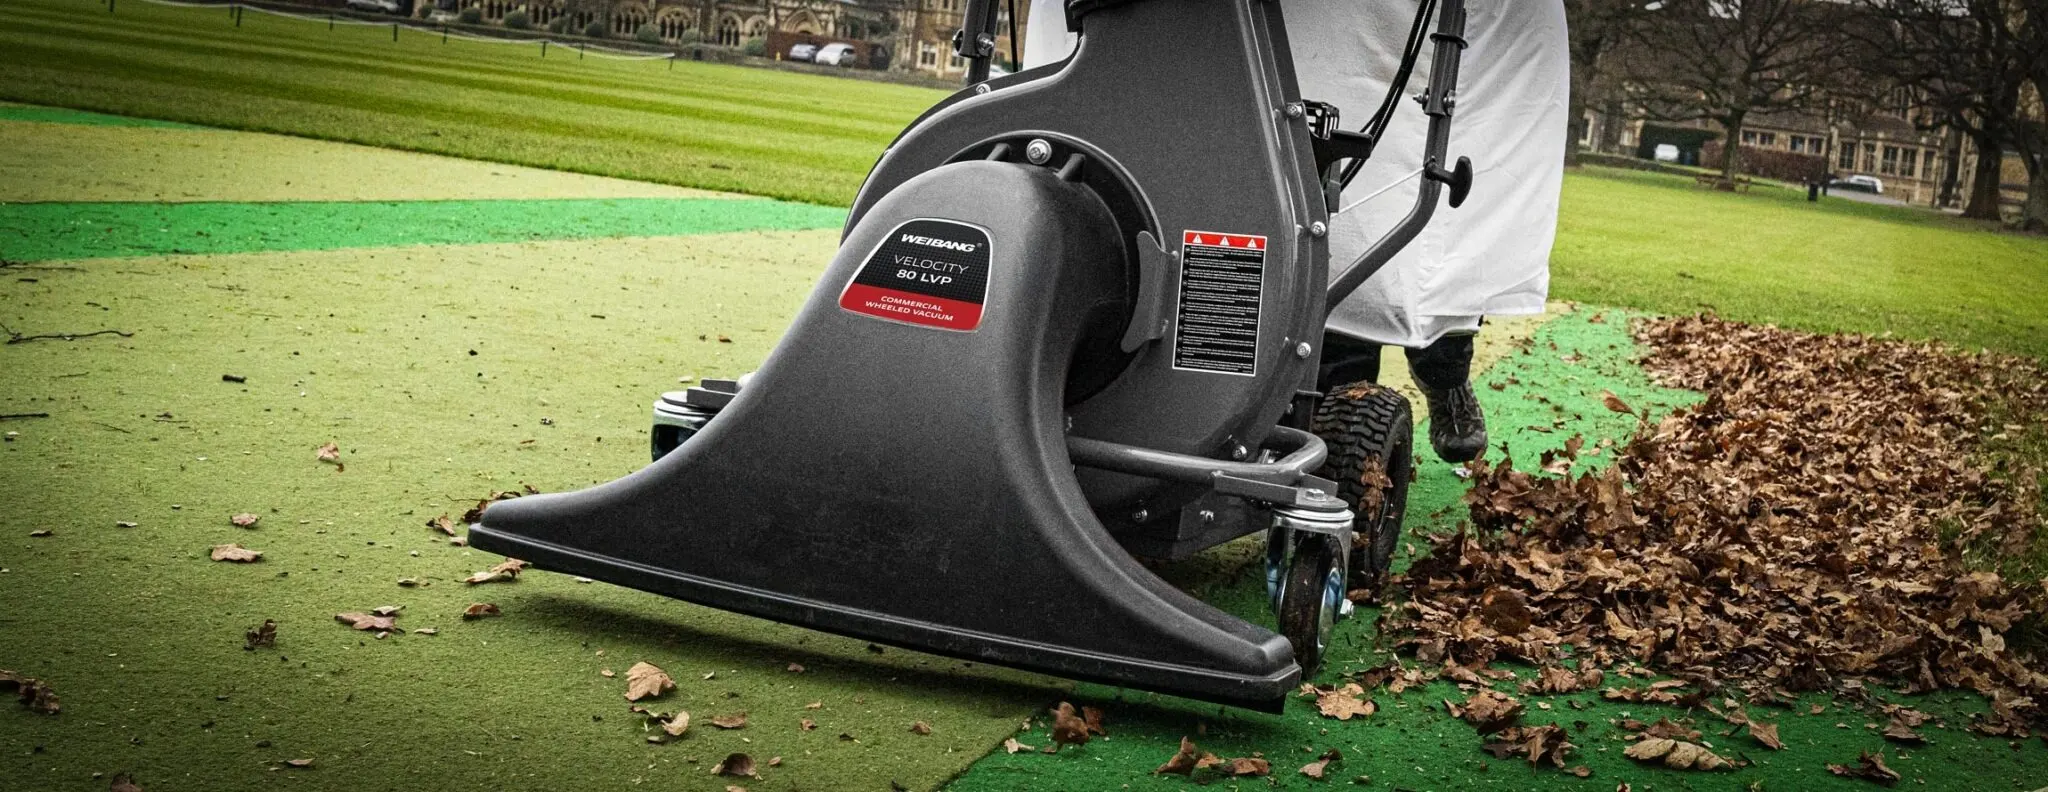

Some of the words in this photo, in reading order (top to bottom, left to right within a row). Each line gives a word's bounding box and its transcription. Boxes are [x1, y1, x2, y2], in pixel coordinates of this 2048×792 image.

[901, 233, 975, 252] WEIBANG
[894, 254, 969, 274] VELOCITY
[896, 269, 917, 280] 80
[920, 273, 952, 285] LVP
[865, 301, 911, 314] WHEELED
[913, 309, 954, 322] VACUUM
[880, 295, 943, 312] COMMERCIAL
